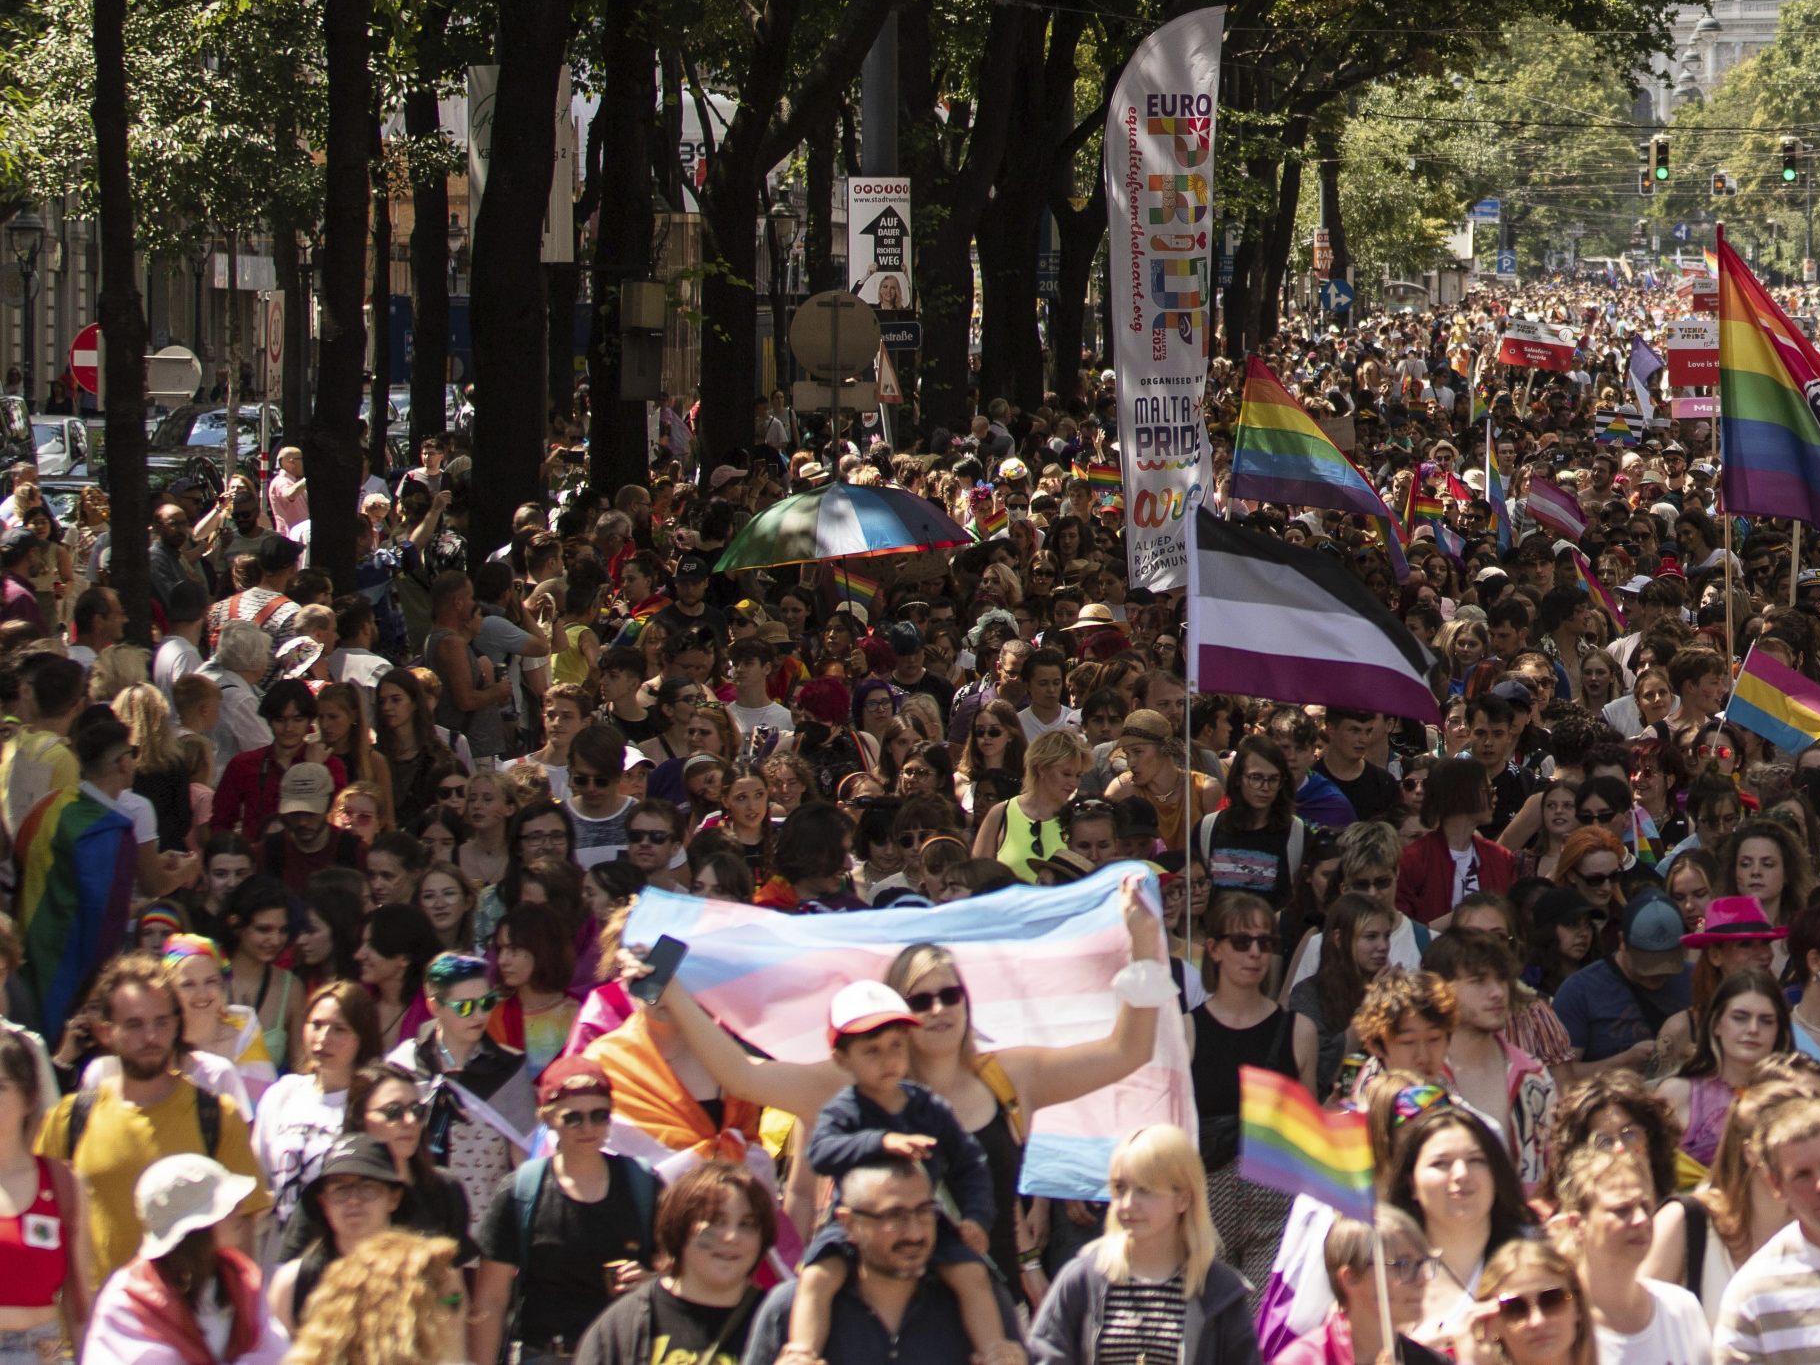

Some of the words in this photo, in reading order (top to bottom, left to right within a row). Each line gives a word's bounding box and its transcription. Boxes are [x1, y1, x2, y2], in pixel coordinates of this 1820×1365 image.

[1147, 94, 1212, 117] EURO
[880, 218, 898, 227] AUF
[1126, 106, 1145, 332] equalityfromtheheart.org
[878, 228, 900, 236] DAUER
[879, 256, 900, 265] WEG
[1503, 259, 1511, 270] P
[1152, 329, 1162, 361] 2023
[1523, 346, 1552, 355] Salesforce
[1526, 353, 1547, 361] Austria
[1140, 377, 1191, 386] ORGANISED
[1135, 395, 1190, 425] MALTA
[1135, 554, 1187, 578] COMMUN
